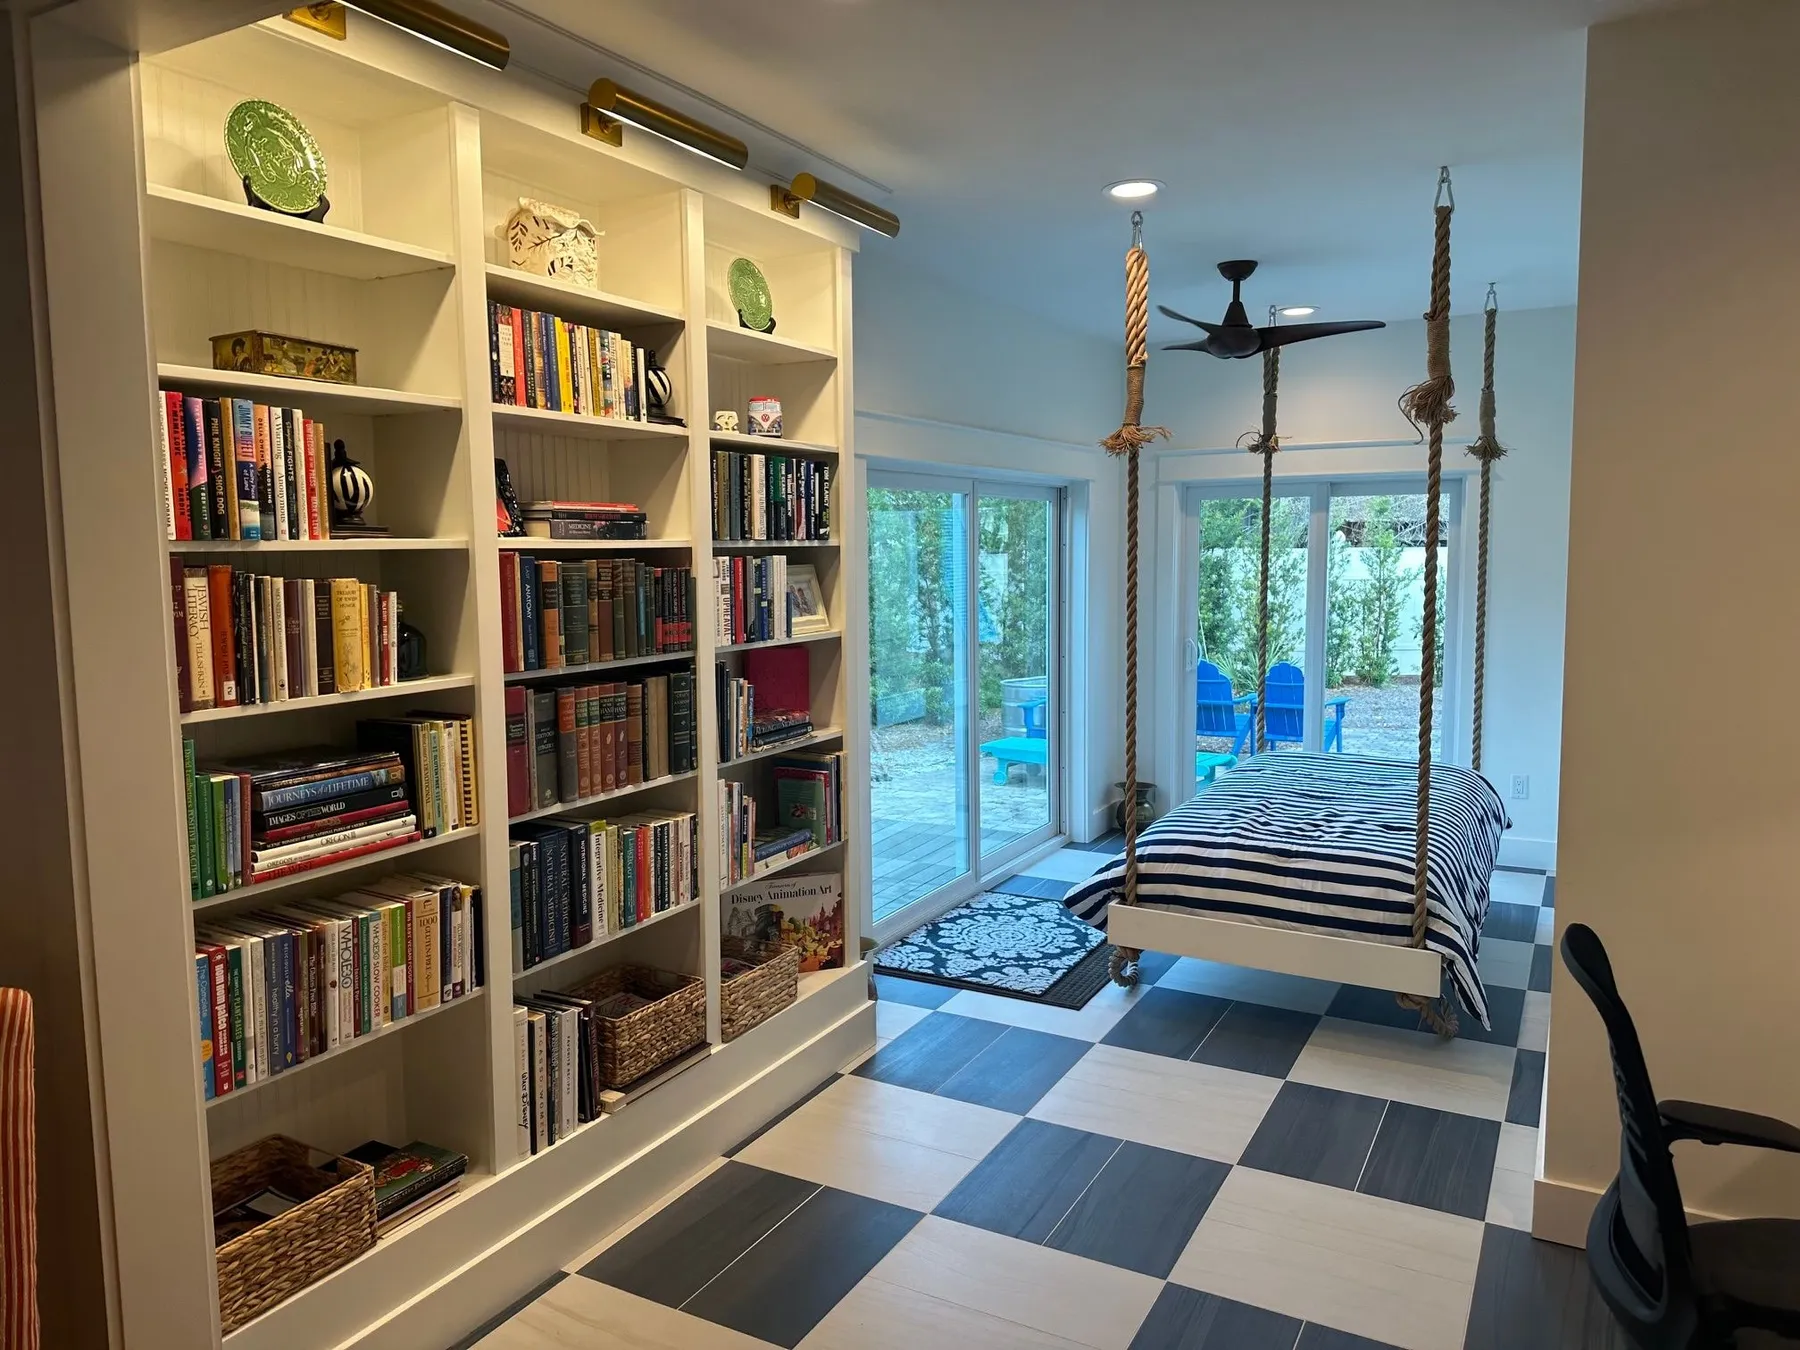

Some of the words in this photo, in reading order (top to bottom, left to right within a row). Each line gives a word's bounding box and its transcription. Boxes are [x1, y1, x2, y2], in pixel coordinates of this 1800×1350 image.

[211, 418, 219, 436] PHIL
[238, 405, 253, 429] JIMMY
[212, 438, 222, 467] KNIGHT
[240, 431, 254, 459] BUFFETT
[275, 423, 284, 460] Warning
[287, 450, 295, 482] FIGHTS
[215, 475, 223, 496] SHOE
[277, 472, 287, 524] Anonymous
[217, 497, 225, 515] DOG
[187, 588, 200, 639] LITERACY
[193, 585, 209, 630] JEWISH
[525, 584, 533, 619] ANATOMY
[723, 597, 731, 637] UPHEAVAL
[267, 787, 318, 808] JOURNEYS
[327, 775, 370, 793] LIFETIME
[268, 811, 296, 826] IMAGES
[321, 801, 346, 815] WORLD
[320, 832, 350, 846] OREGON
[267, 856, 293, 868] OREGON
[559, 844, 568, 890] NATURAL
[580, 840, 588, 881] NUTRITIONAL
[593, 832, 605, 881] Integrative
[545, 849, 555, 894] NATURAL
[596, 883, 607, 924] Medicine
[731, 893, 763, 904] Disney
[768, 886, 817, 900] Animation
[819, 884, 833, 895] Art
[547, 897, 557, 944] MEDICINE
[561, 892, 571, 939] MEDICINE
[199, 965, 207, 979] The
[214, 963, 225, 984] nom
[373, 962, 381, 983] SLOW
[199, 980, 208, 1018] Complete
[215, 985, 226, 1005] nom
[271, 987, 281, 1017] healthy
[285, 979, 294, 1000] ella
[373, 985, 382, 1018] COOKER
[215, 1005, 229, 1030] paleo
[234, 998, 243, 1040] PLANT-BASED
[257, 996, 266, 1018] meals
[258, 1020, 266, 1039] made
[258, 1041, 267, 1066] simple
[272, 1034, 281, 1056] hurry
[520, 1072, 529, 1091] WALT
